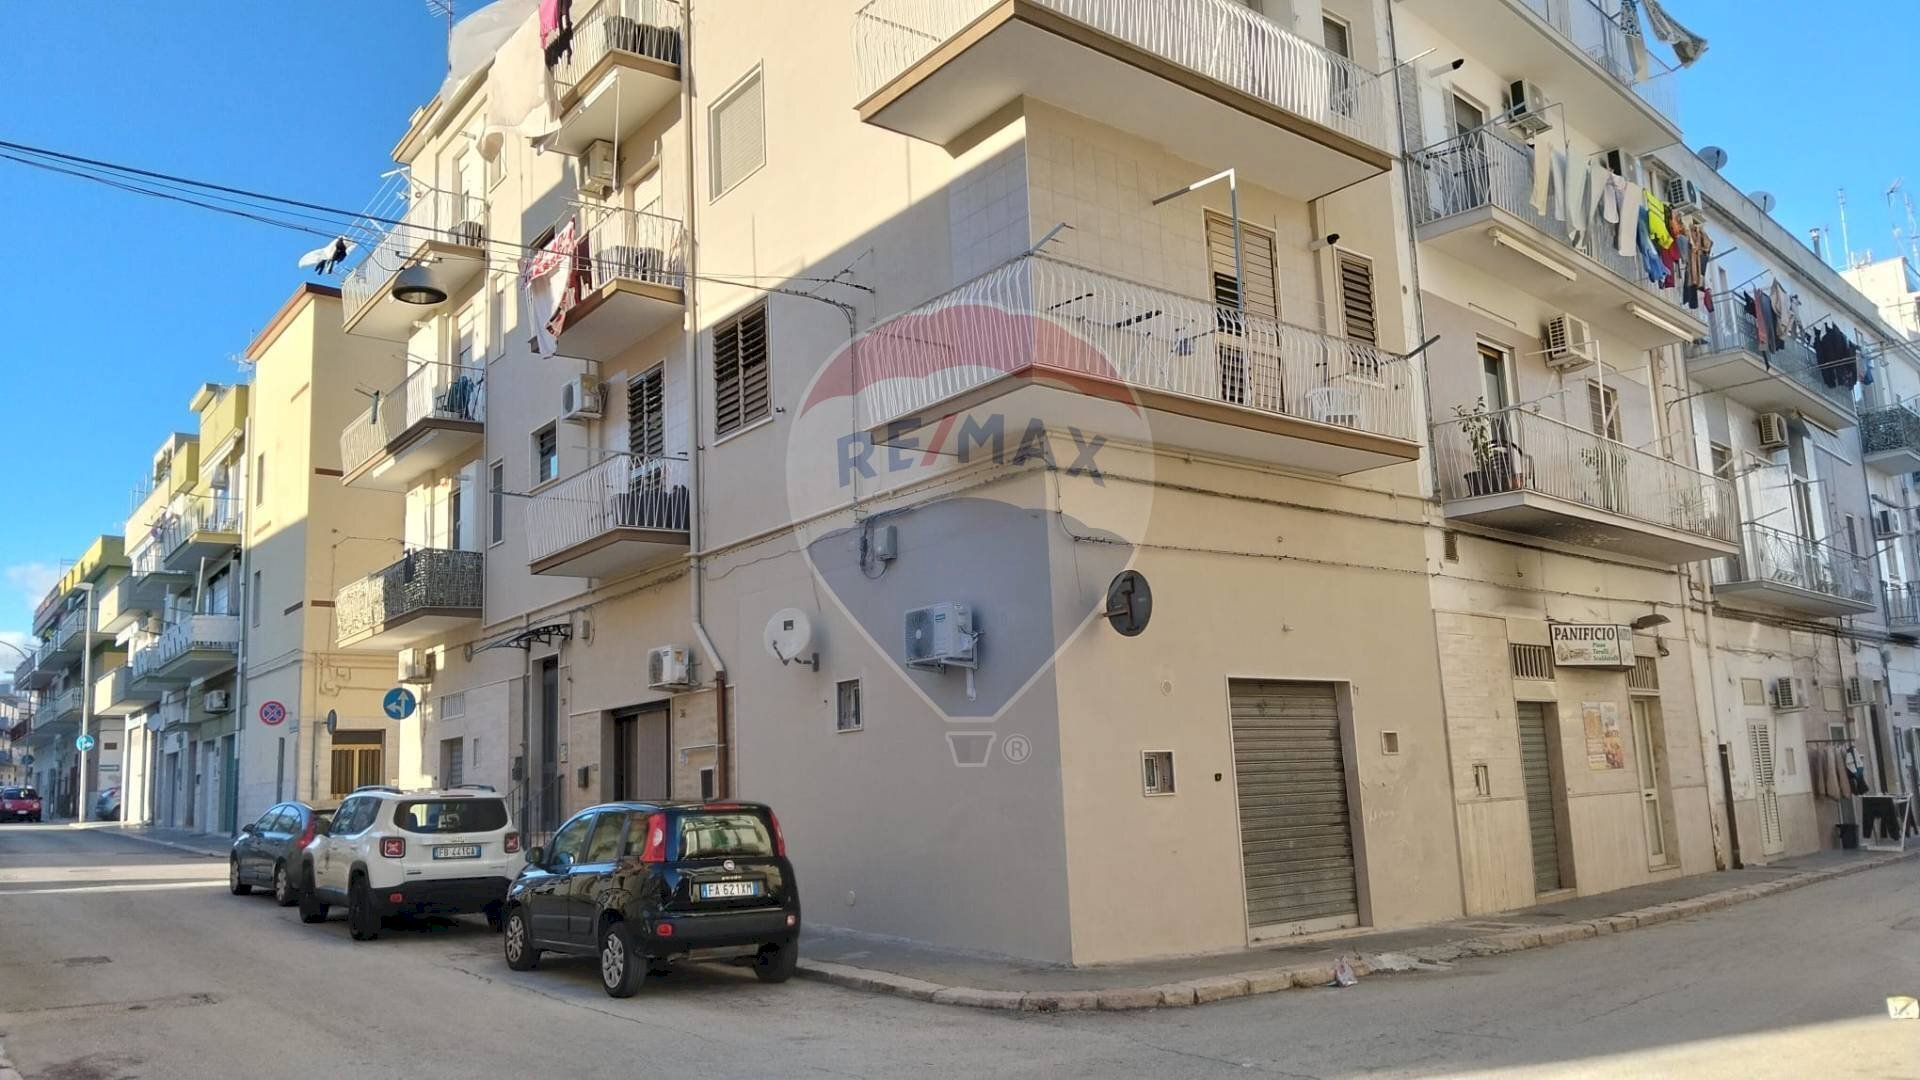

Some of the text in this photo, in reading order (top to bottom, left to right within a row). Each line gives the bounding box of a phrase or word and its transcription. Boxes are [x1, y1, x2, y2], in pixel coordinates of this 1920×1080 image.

[1554, 627, 1615, 641] PANIFICIO
[708, 882, 752, 896] FA 621XM
